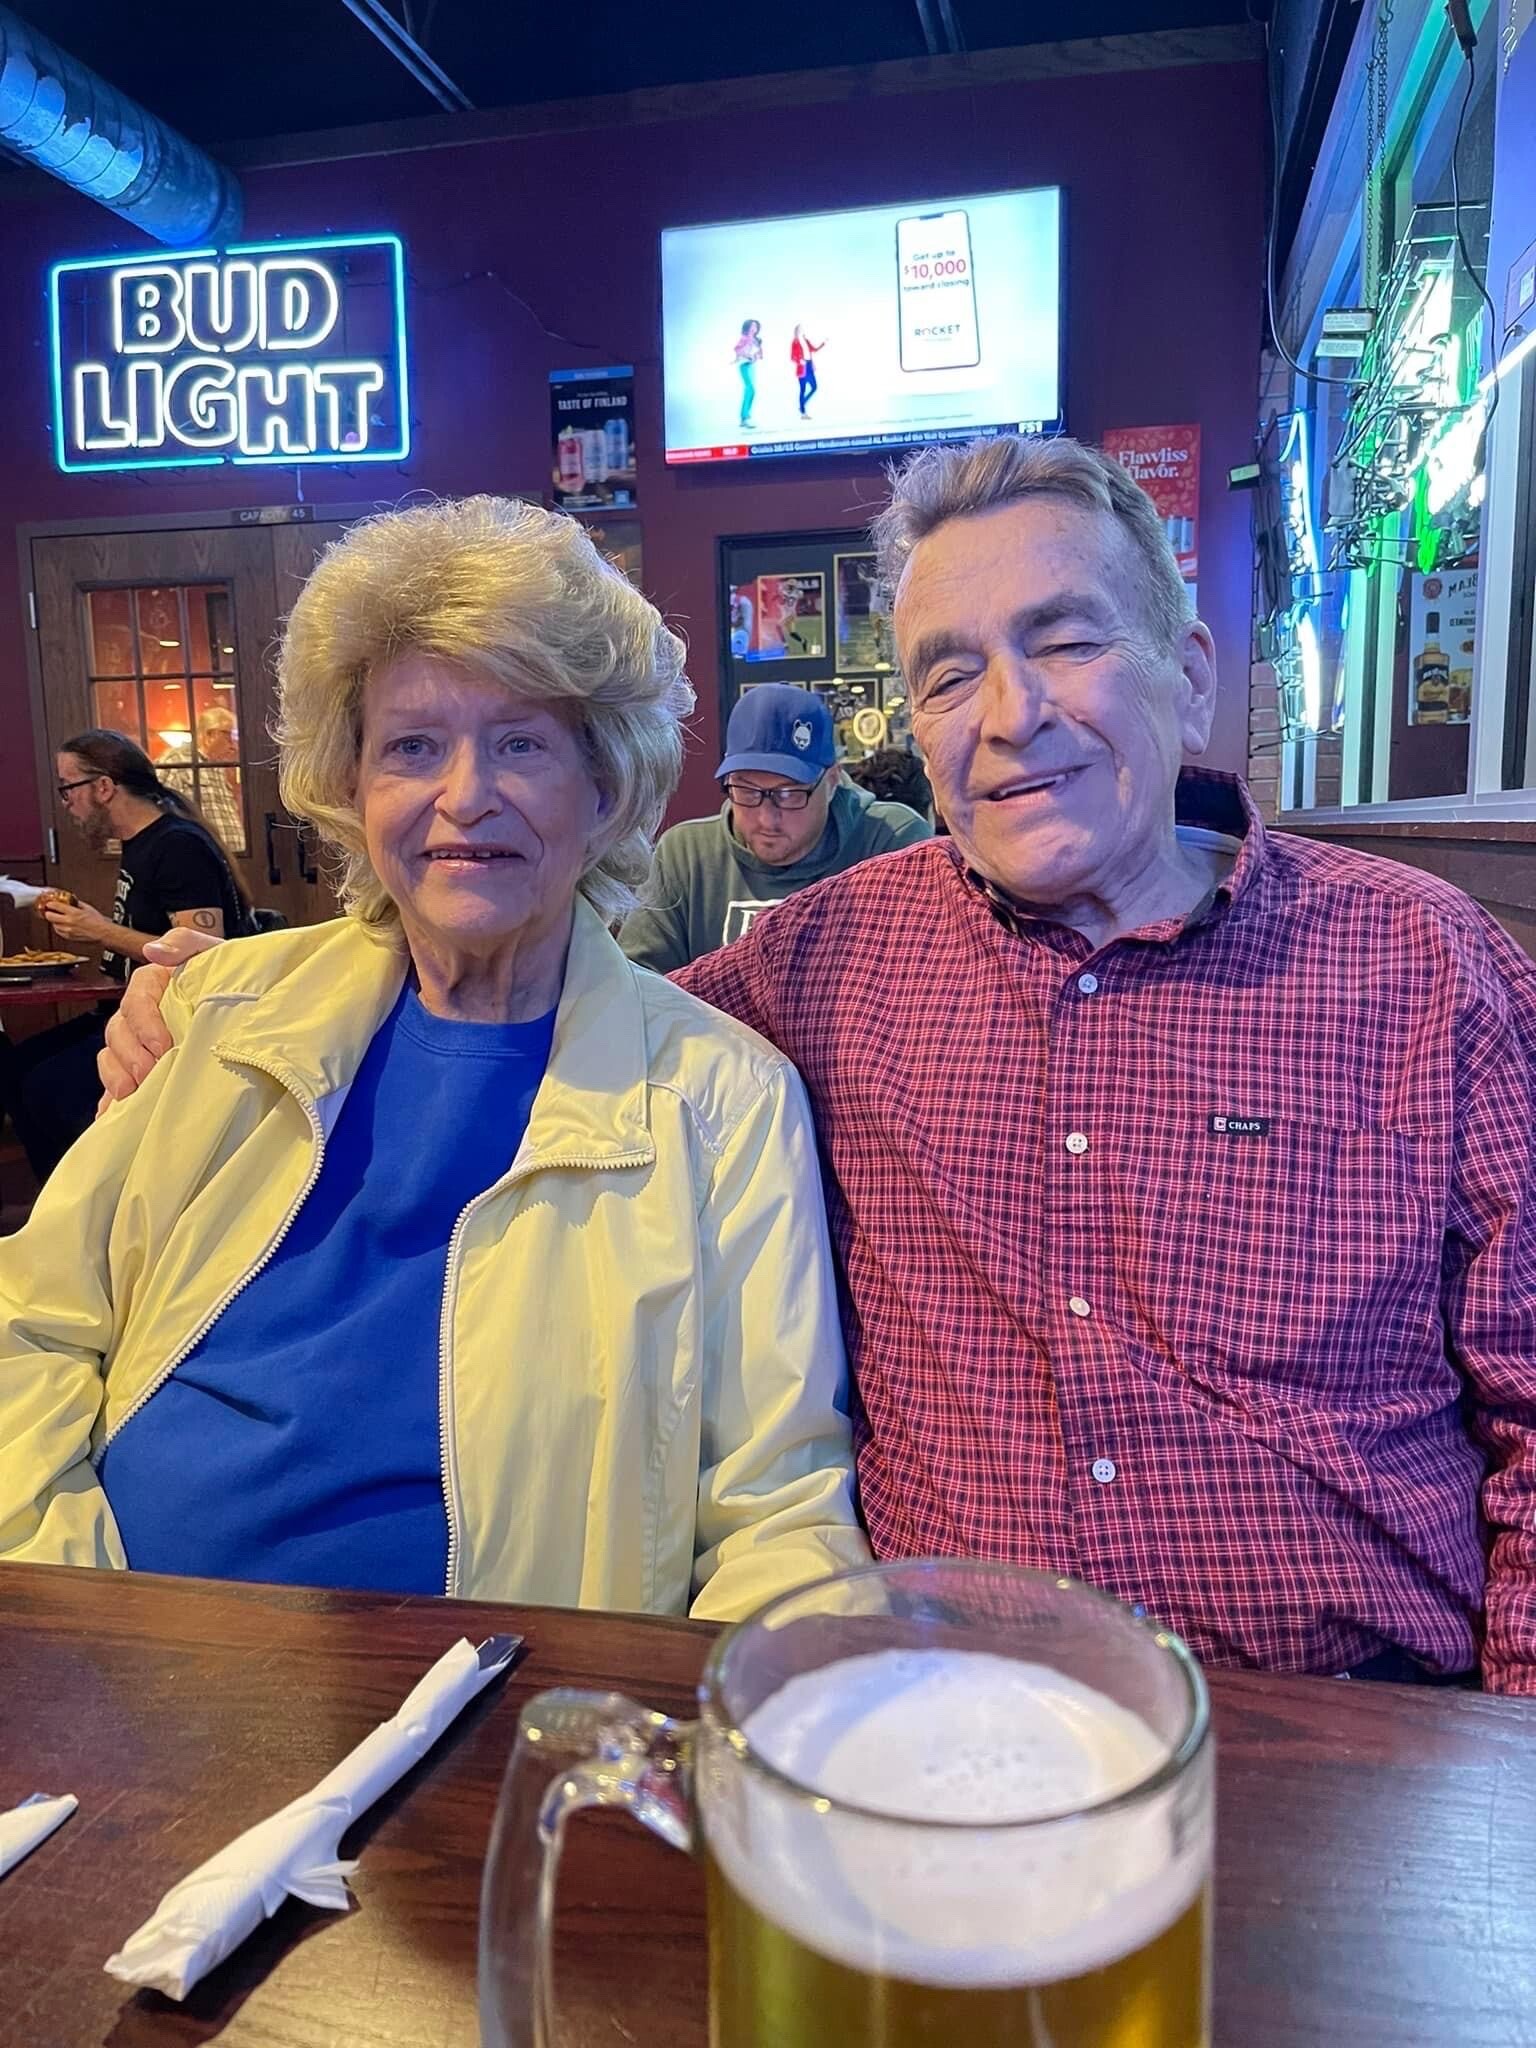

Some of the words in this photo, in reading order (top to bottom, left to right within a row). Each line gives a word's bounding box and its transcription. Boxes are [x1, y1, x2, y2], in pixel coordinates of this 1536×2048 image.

[913, 253, 929, 261] Get
[904, 259, 966, 280] $10,000
[904, 282, 935, 292] toward
[937, 279, 969, 288] closing
[113, 259, 338, 355] BUD
[914, 323, 960, 336] ROCKET
[73, 357, 384, 456] LIGHT
[558, 400, 581, 410] TASTE
[582, 398, 592, 408] OF
[594, 396, 628, 408] FINLAND
[1228, 1121, 1260, 1130] CHAPS
